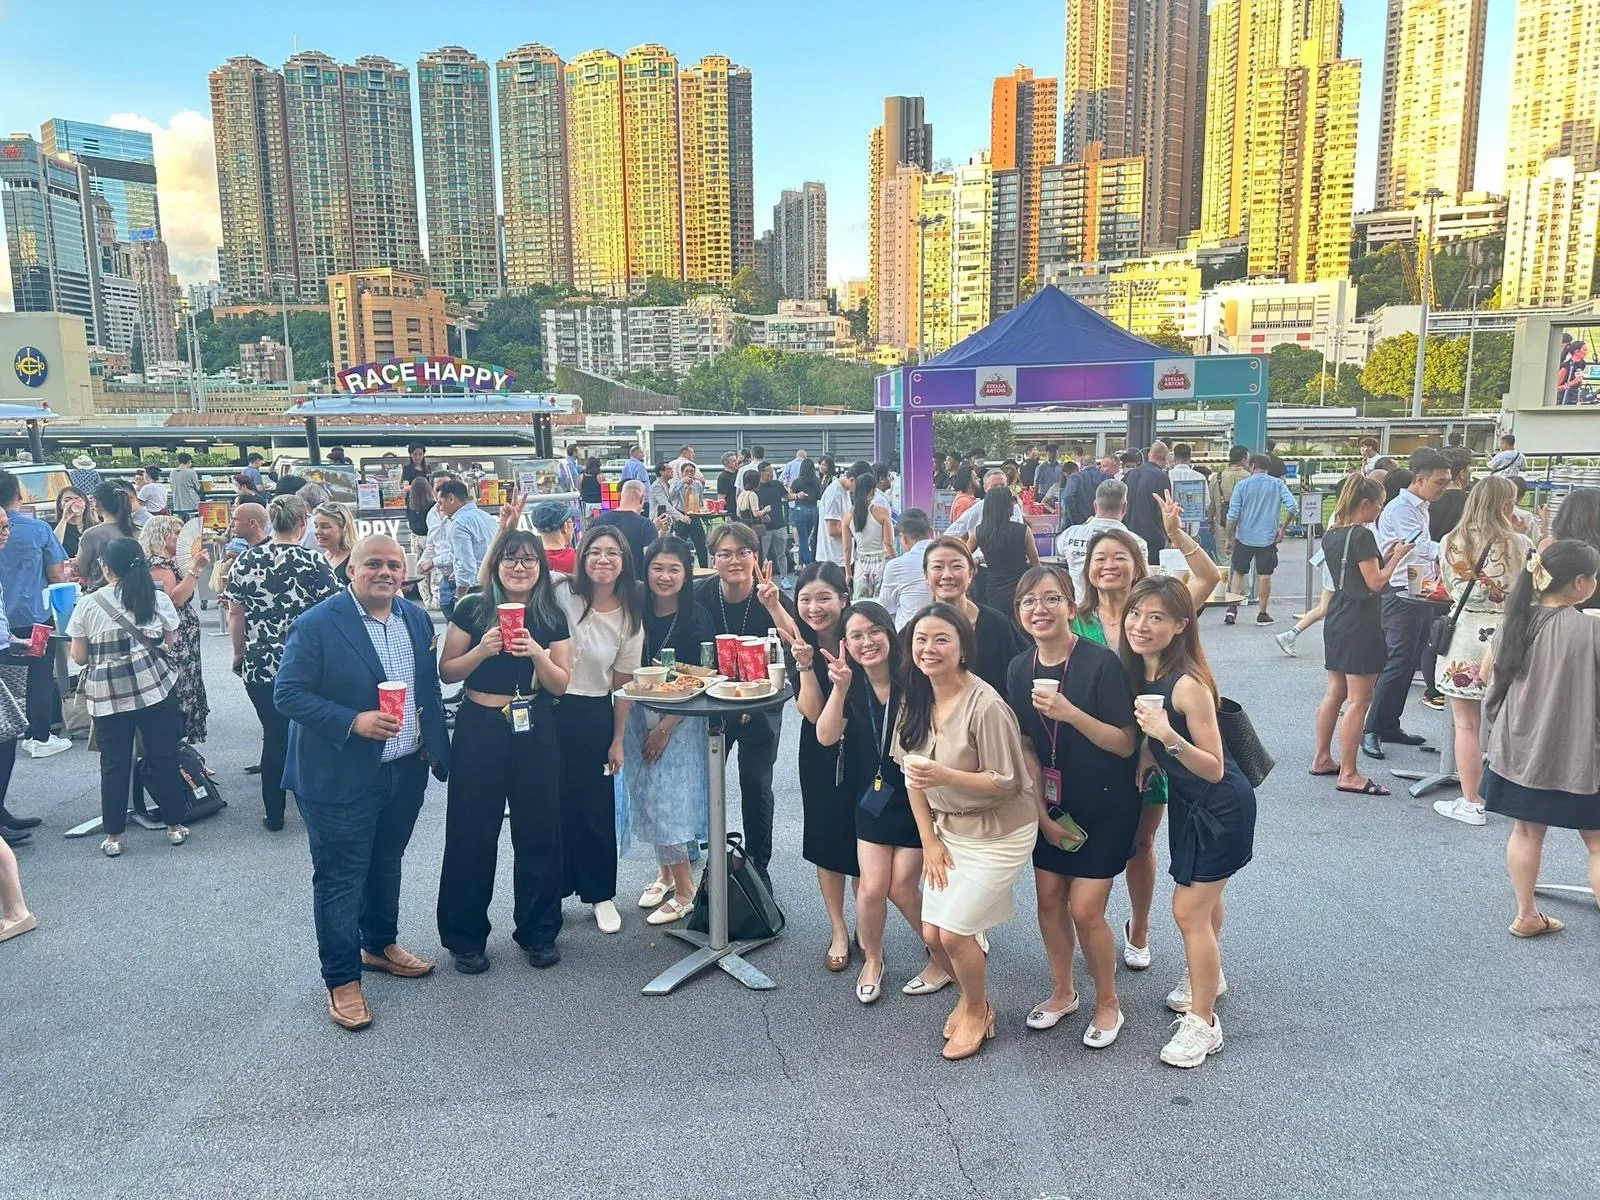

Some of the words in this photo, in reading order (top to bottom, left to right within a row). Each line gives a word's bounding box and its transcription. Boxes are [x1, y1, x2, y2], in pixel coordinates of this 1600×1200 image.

[344, 362, 417, 394] RACE
[424, 361, 509, 391] HAPPY
[358, 519, 400, 542] PPY
